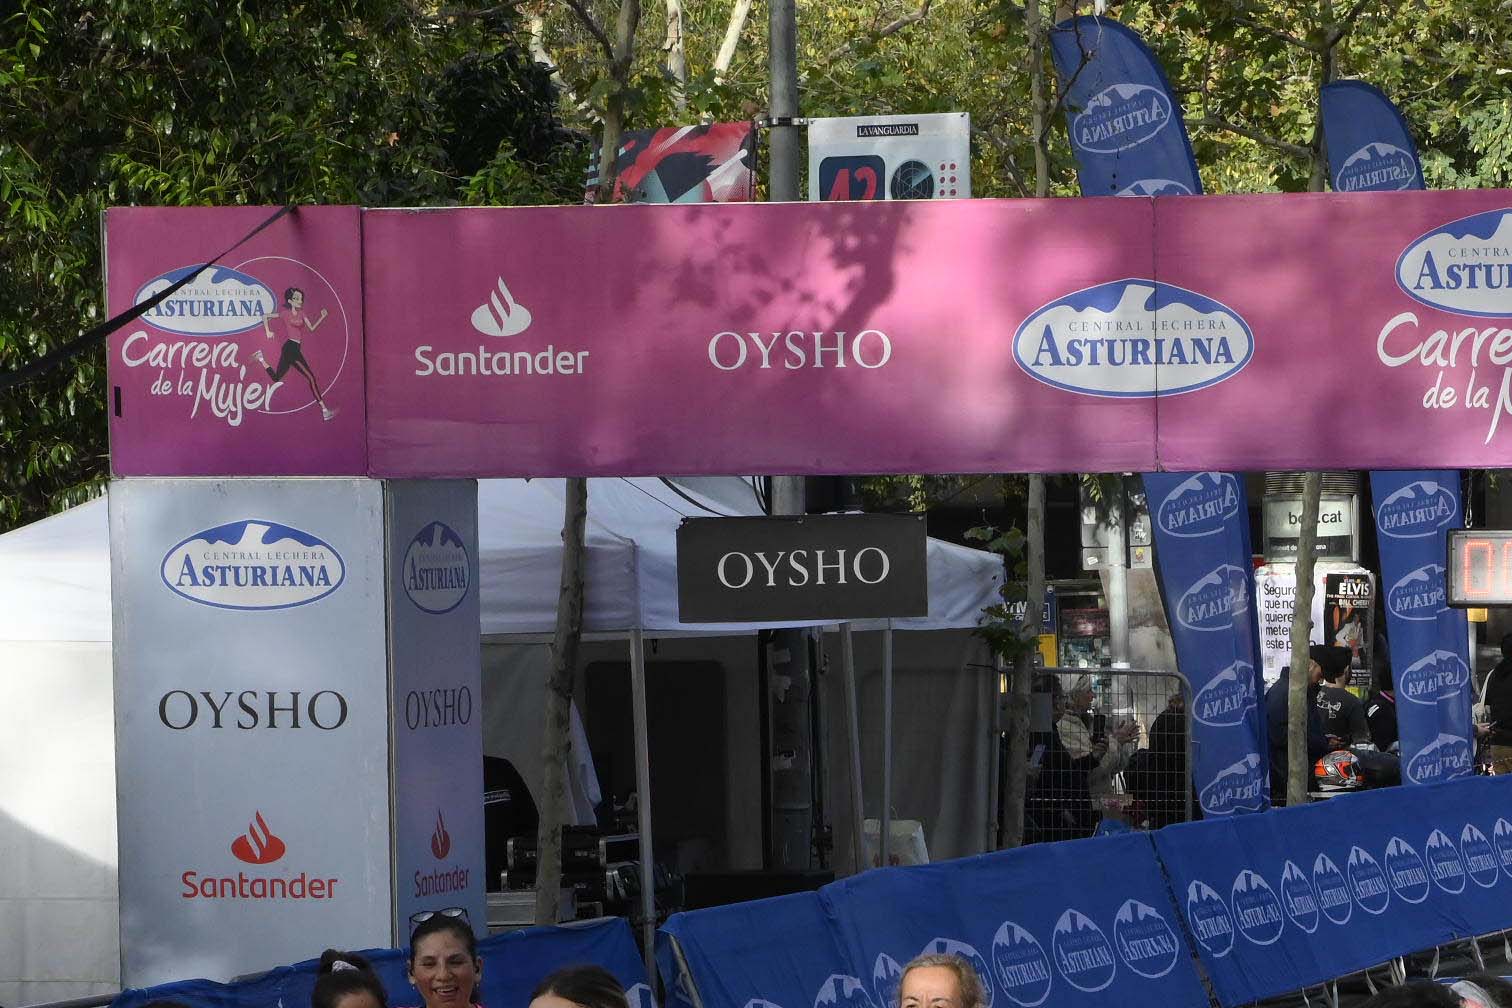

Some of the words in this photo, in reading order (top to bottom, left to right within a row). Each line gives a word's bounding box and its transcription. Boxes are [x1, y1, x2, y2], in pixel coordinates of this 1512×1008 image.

[172, 288, 213, 297] ENTRAL
[215, 288, 261, 296] LECHERA
[1068, 320, 1144, 332] CENTRAL
[1151, 319, 1227, 331] LECHERA
[121, 331, 239, 368] Carrera
[415, 345, 589, 376] Santander
[708, 329, 892, 371] OYSHO
[1031, 324, 1235, 367] ASTURIANA
[151, 370, 172, 395] de
[178, 369, 193, 396] la
[191, 366, 283, 427] Mujer
[1422, 371, 1457, 408] de
[1465, 368, 1489, 409] la
[175, 554, 332, 587] ASTURIANA
[203, 552, 260, 561] CENTRAL
[266, 551, 325, 560] LECHERA
[717, 547, 890, 589] OYSHO
[408, 557, 466, 592] ASTURIANA
[1339, 583, 1369, 595] ELVIS
[1264, 600, 1280, 610] que
[1265, 611, 1293, 624] quiere
[1266, 625, 1290, 636] mete
[1266, 640, 1284, 649] este
[158, 690, 348, 730] OYSHO
[405, 686, 472, 731] OYSHO
[182, 871, 337, 899] Santander
[415, 868, 470, 898] Santander
